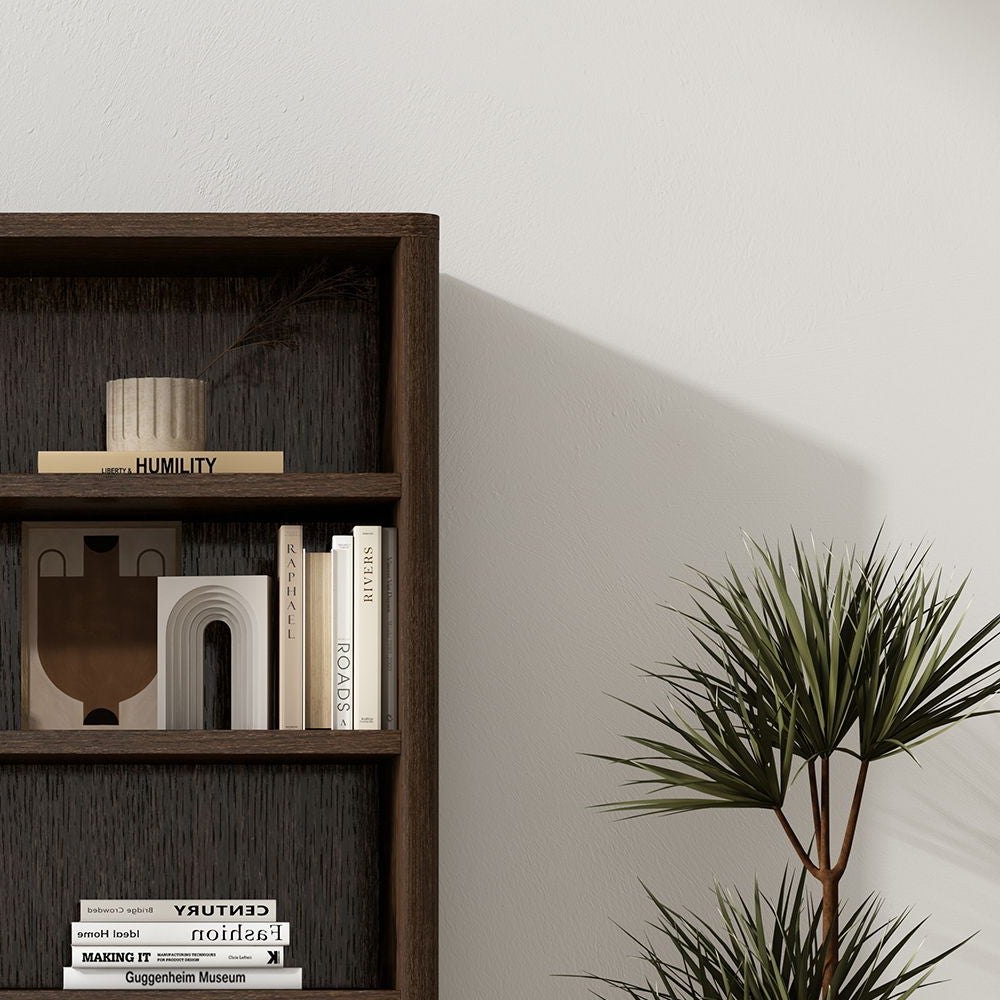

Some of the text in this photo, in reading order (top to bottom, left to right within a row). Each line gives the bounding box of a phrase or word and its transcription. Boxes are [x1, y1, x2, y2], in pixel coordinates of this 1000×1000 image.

[136, 457, 217, 474] HUMILITY
[287, 543, 297, 639] RAPHAEL
[363, 546, 373, 603] RIVERS
[337, 643, 350, 712] ROADS
[82, 952, 151, 963] MAKING IT
[125, 971, 246, 986] Guggenheim Museum
